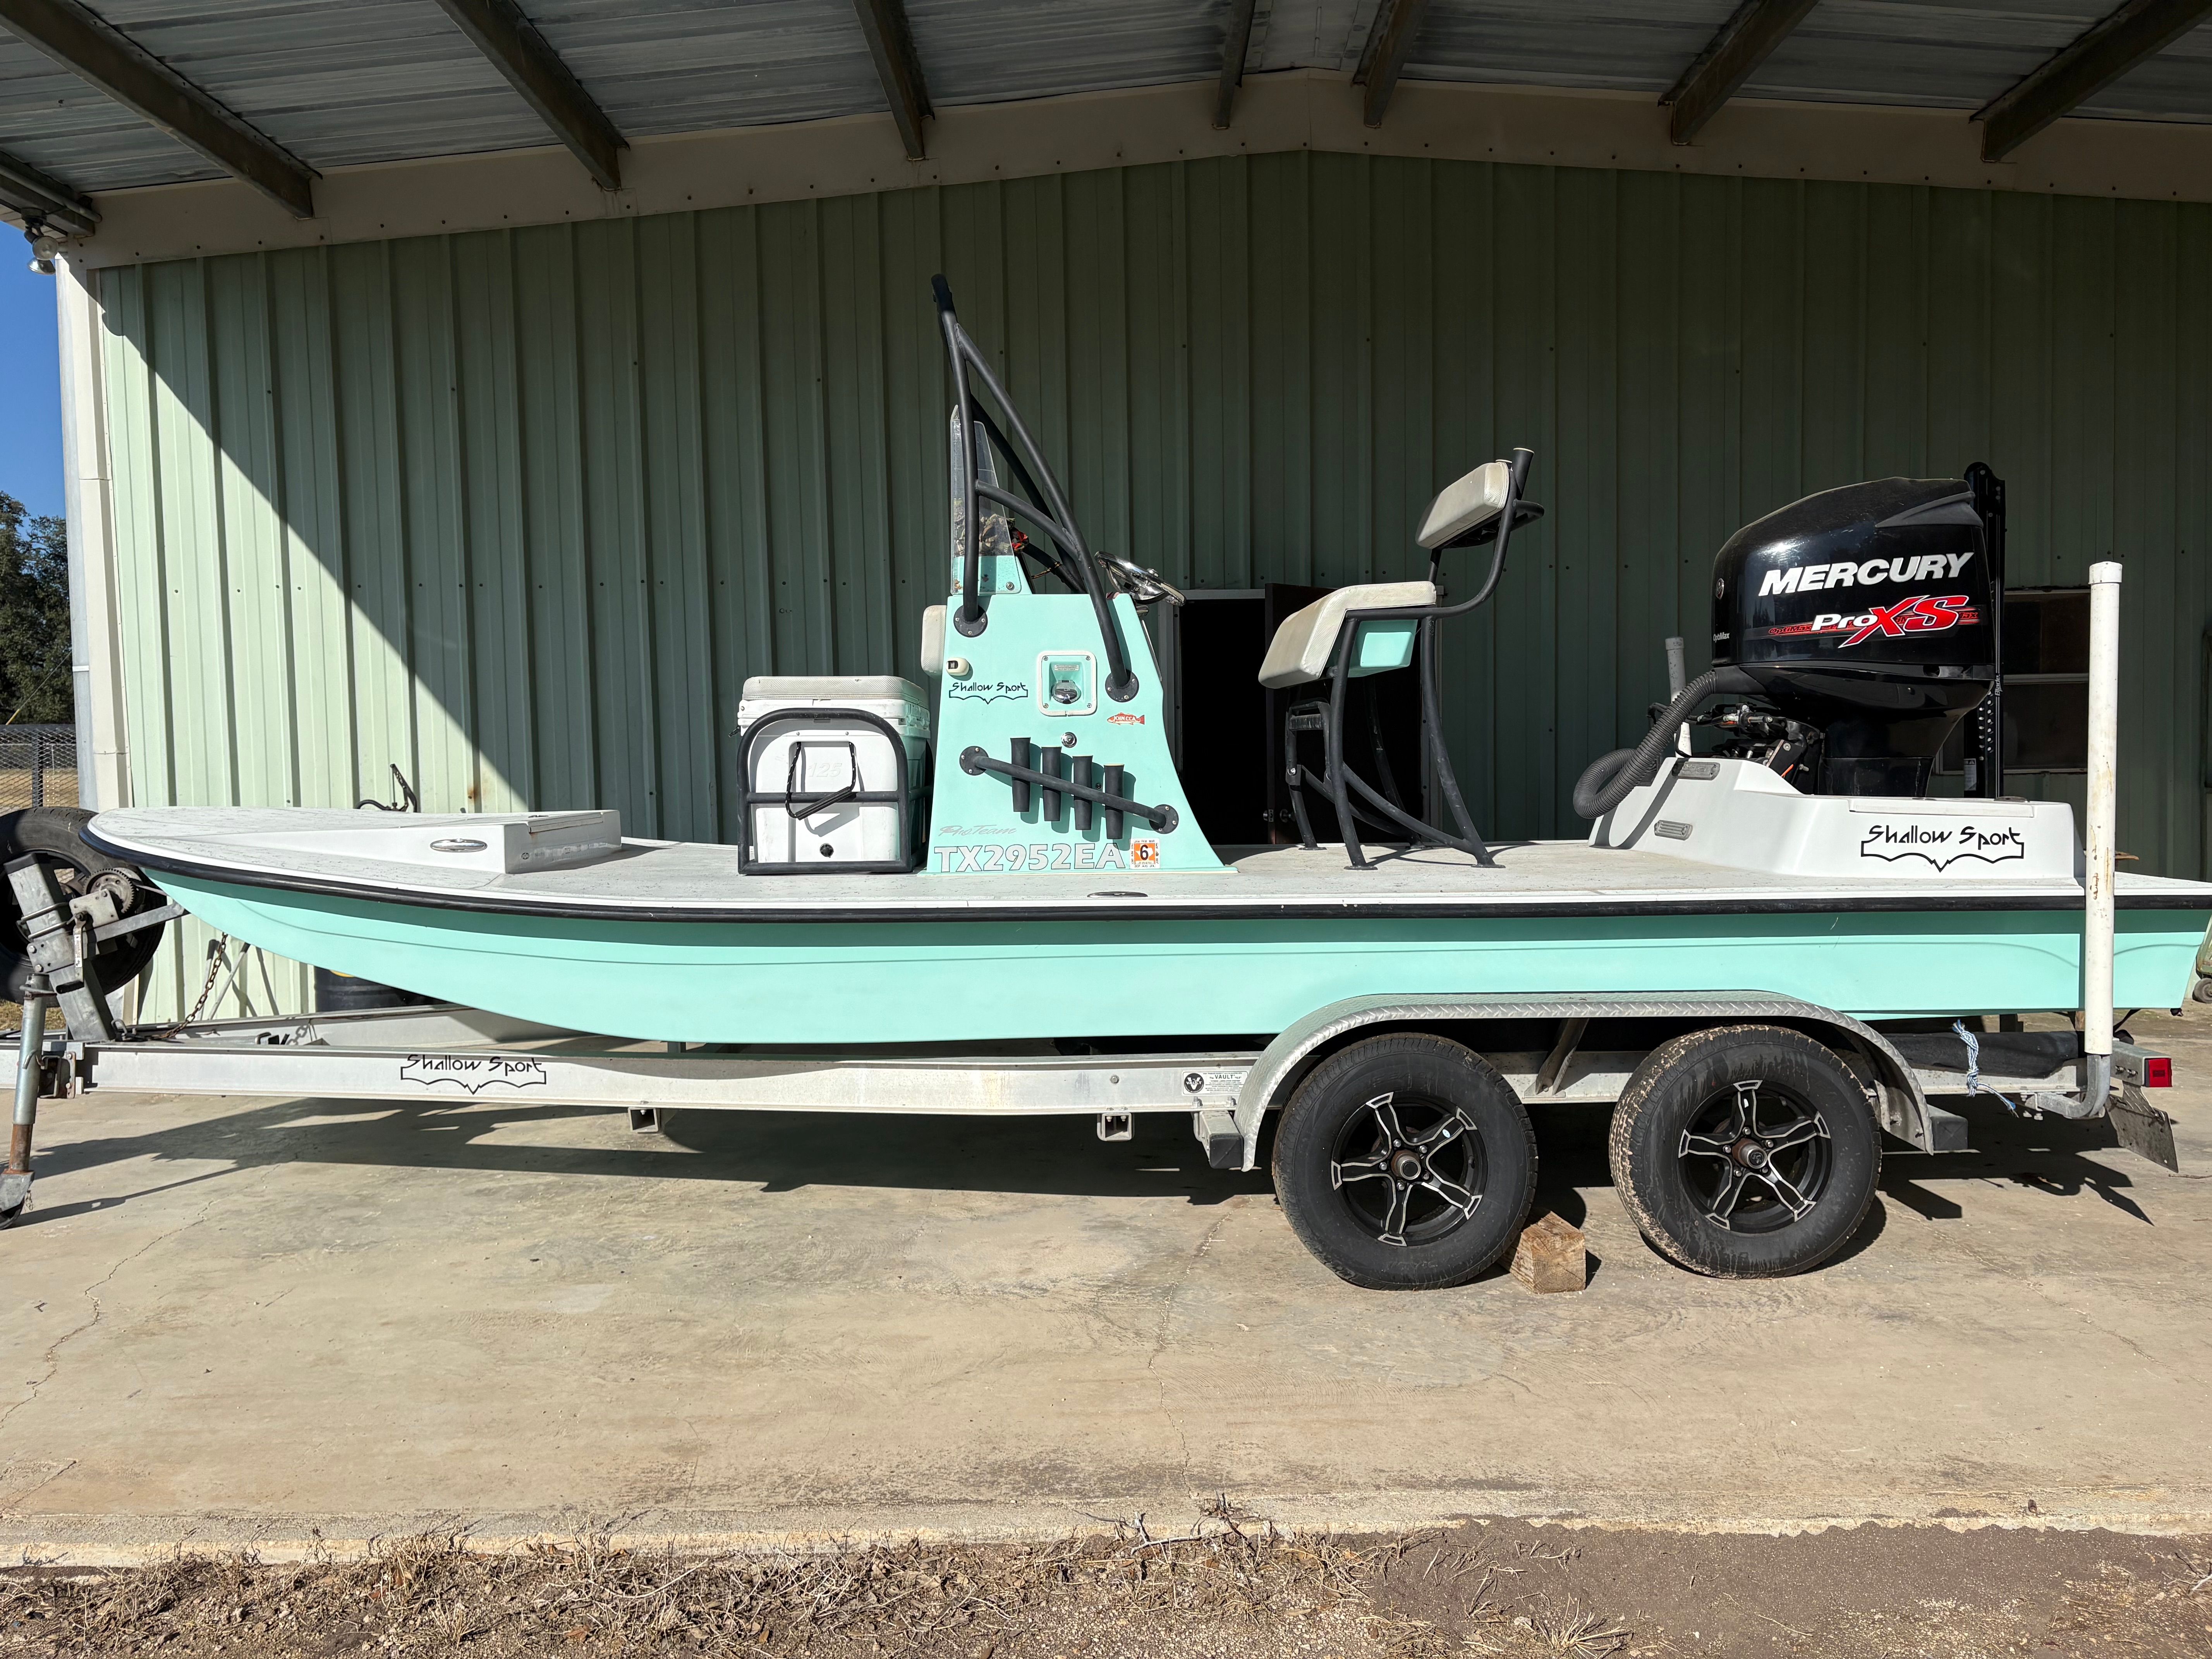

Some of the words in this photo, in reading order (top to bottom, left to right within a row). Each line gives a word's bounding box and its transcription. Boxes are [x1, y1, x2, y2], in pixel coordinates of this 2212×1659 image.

[1759, 552, 1974, 596] MERCURY
[951, 682, 993, 691] Shallow
[996, 682, 1026, 694] Sport
[807, 763, 842, 777] 125
[972, 824, 1017, 835] Team
[1869, 825, 1953, 843] Shallow
[1959, 826, 2021, 850] Sport
[934, 843, 1126, 872] TX2952EA
[1140, 844, 1149, 860] 6
[407, 1054, 481, 1071] Shallow
[488, 1056, 542, 1076] Sport
